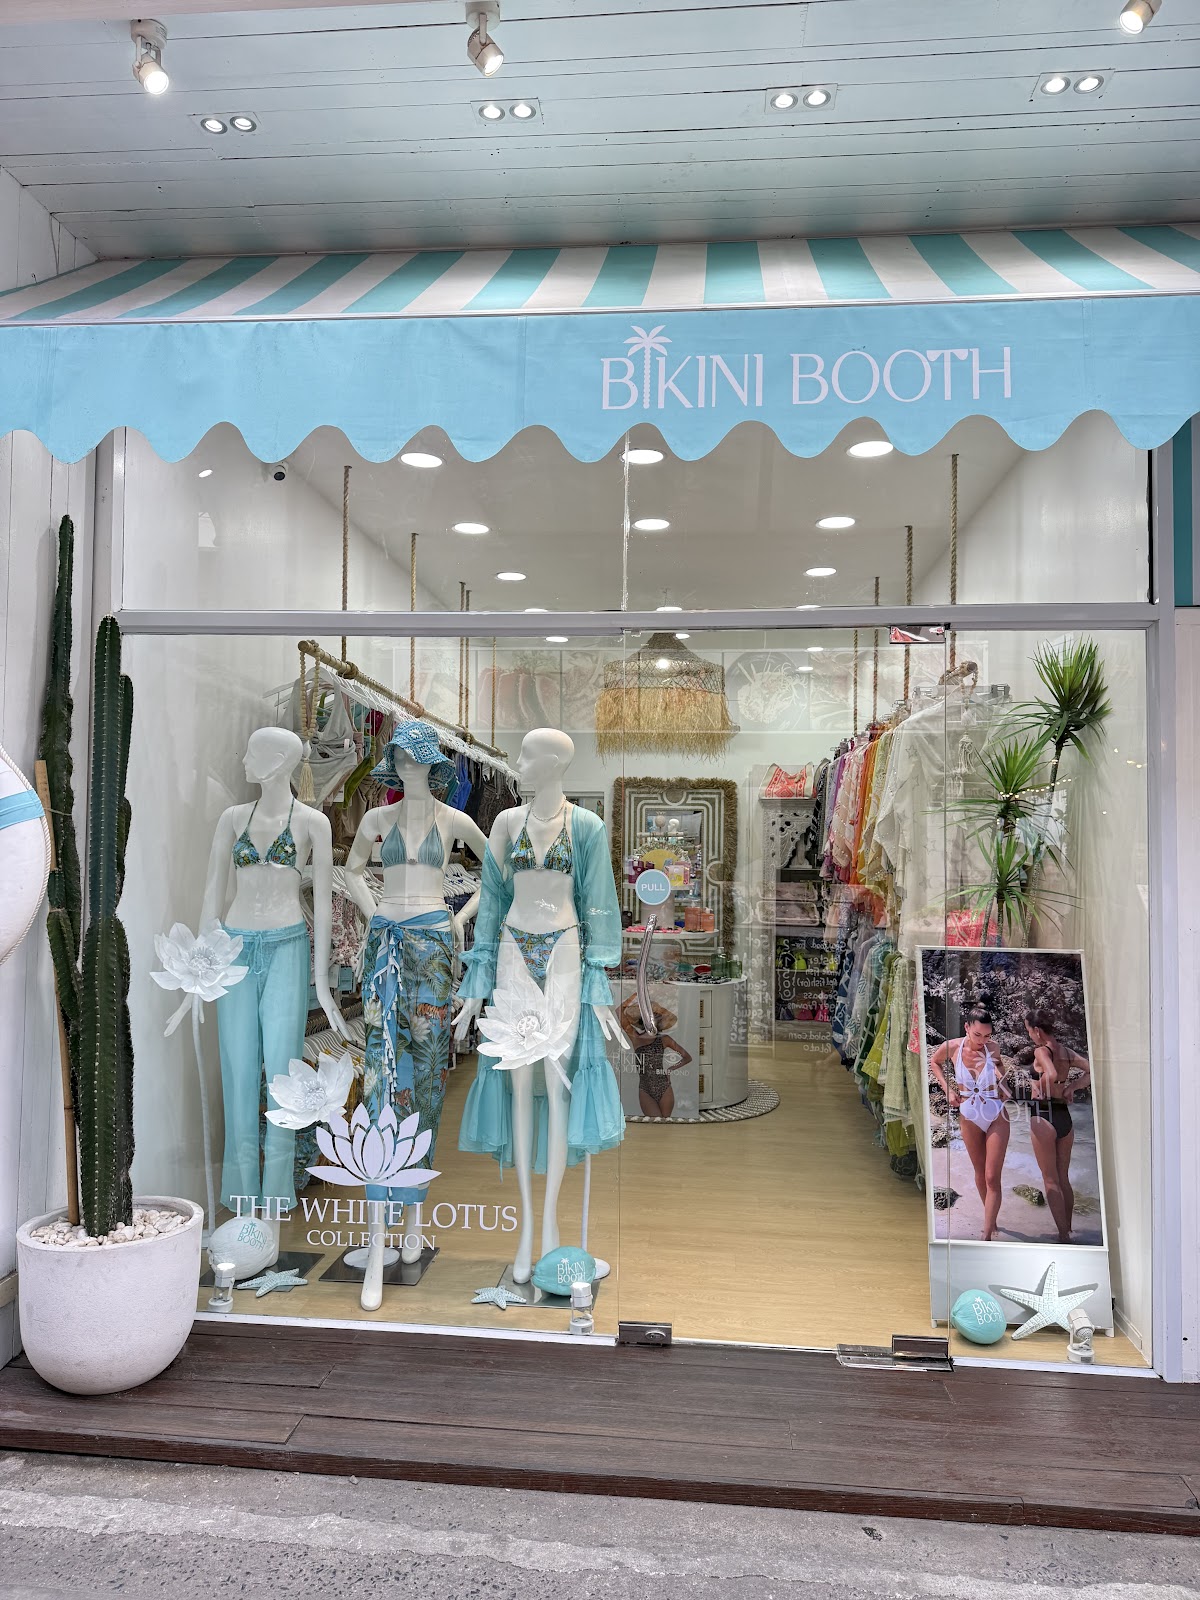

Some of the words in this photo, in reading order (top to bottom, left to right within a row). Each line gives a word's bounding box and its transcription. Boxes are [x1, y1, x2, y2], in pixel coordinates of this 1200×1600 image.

[600, 325, 764, 409] BIKINI
[790, 346, 1012, 404] BOOTH
[641, 883, 666, 892] PULL
[613, 1064, 645, 1075] OOTH
[229, 1195, 292, 1222] THE
[300, 1198, 405, 1227] WHITE
[414, 1202, 519, 1232] LOTUS
[237, 1232, 265, 1252] BOOTH
[306, 1229, 437, 1251] COLLECTION
[557, 1272, 587, 1284] BOOTH
